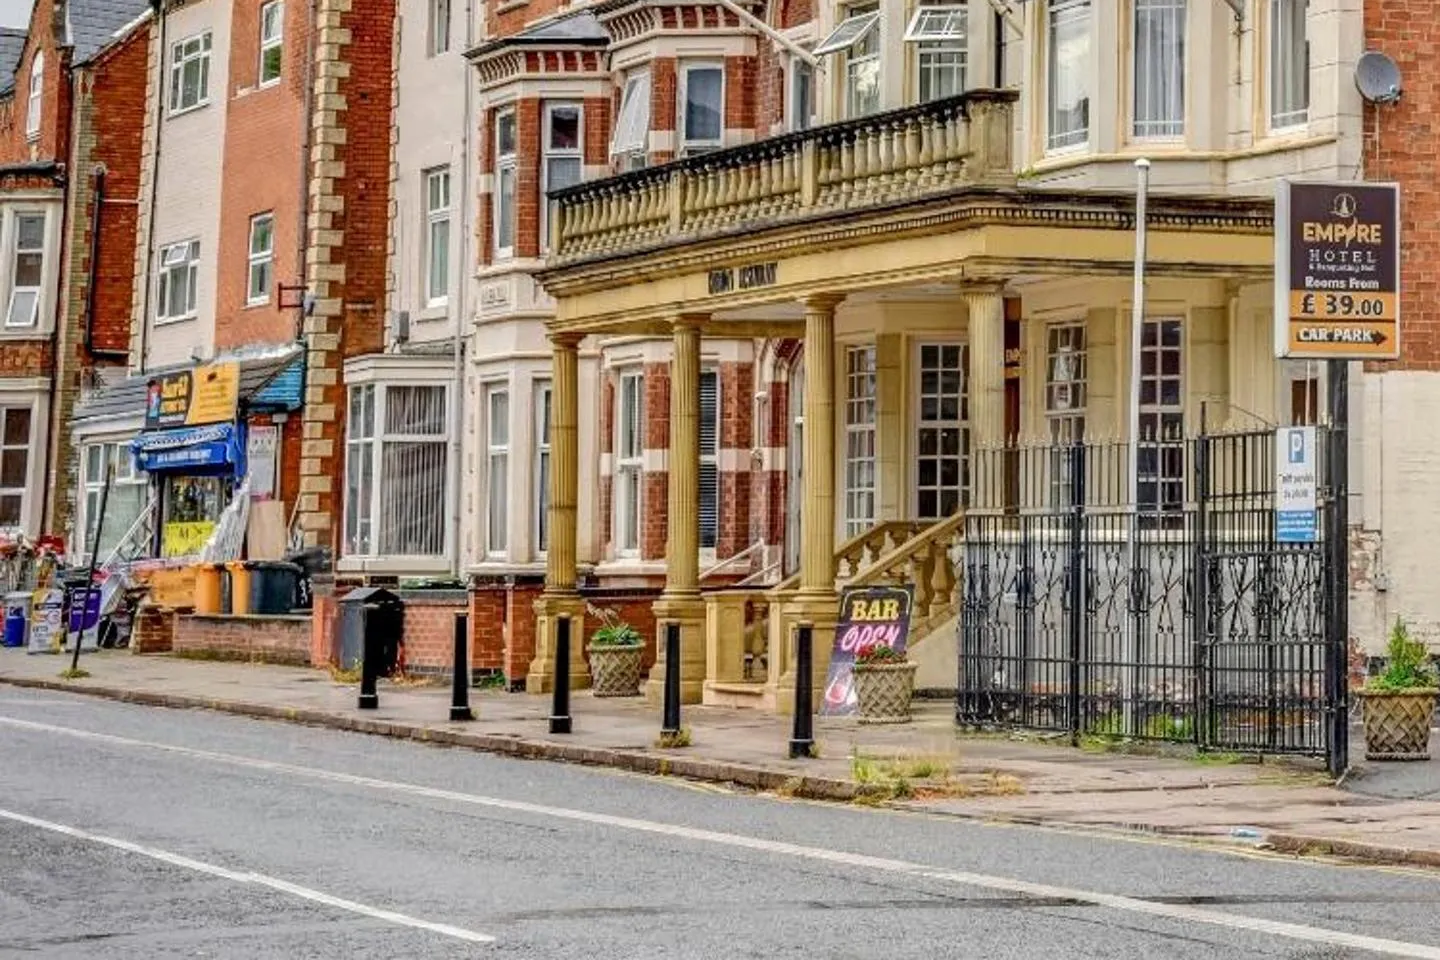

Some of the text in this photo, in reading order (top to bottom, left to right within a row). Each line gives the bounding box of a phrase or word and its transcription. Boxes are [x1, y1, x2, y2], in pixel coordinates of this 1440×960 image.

[1303, 220, 1381, 245] EMPIRE
[1309, 249, 1376, 263] HOTEL
[1305, 276, 1379, 289] Rooms From
[1300, 328, 1374, 341] CAR PARK
[850, 599, 899, 621] BAR
